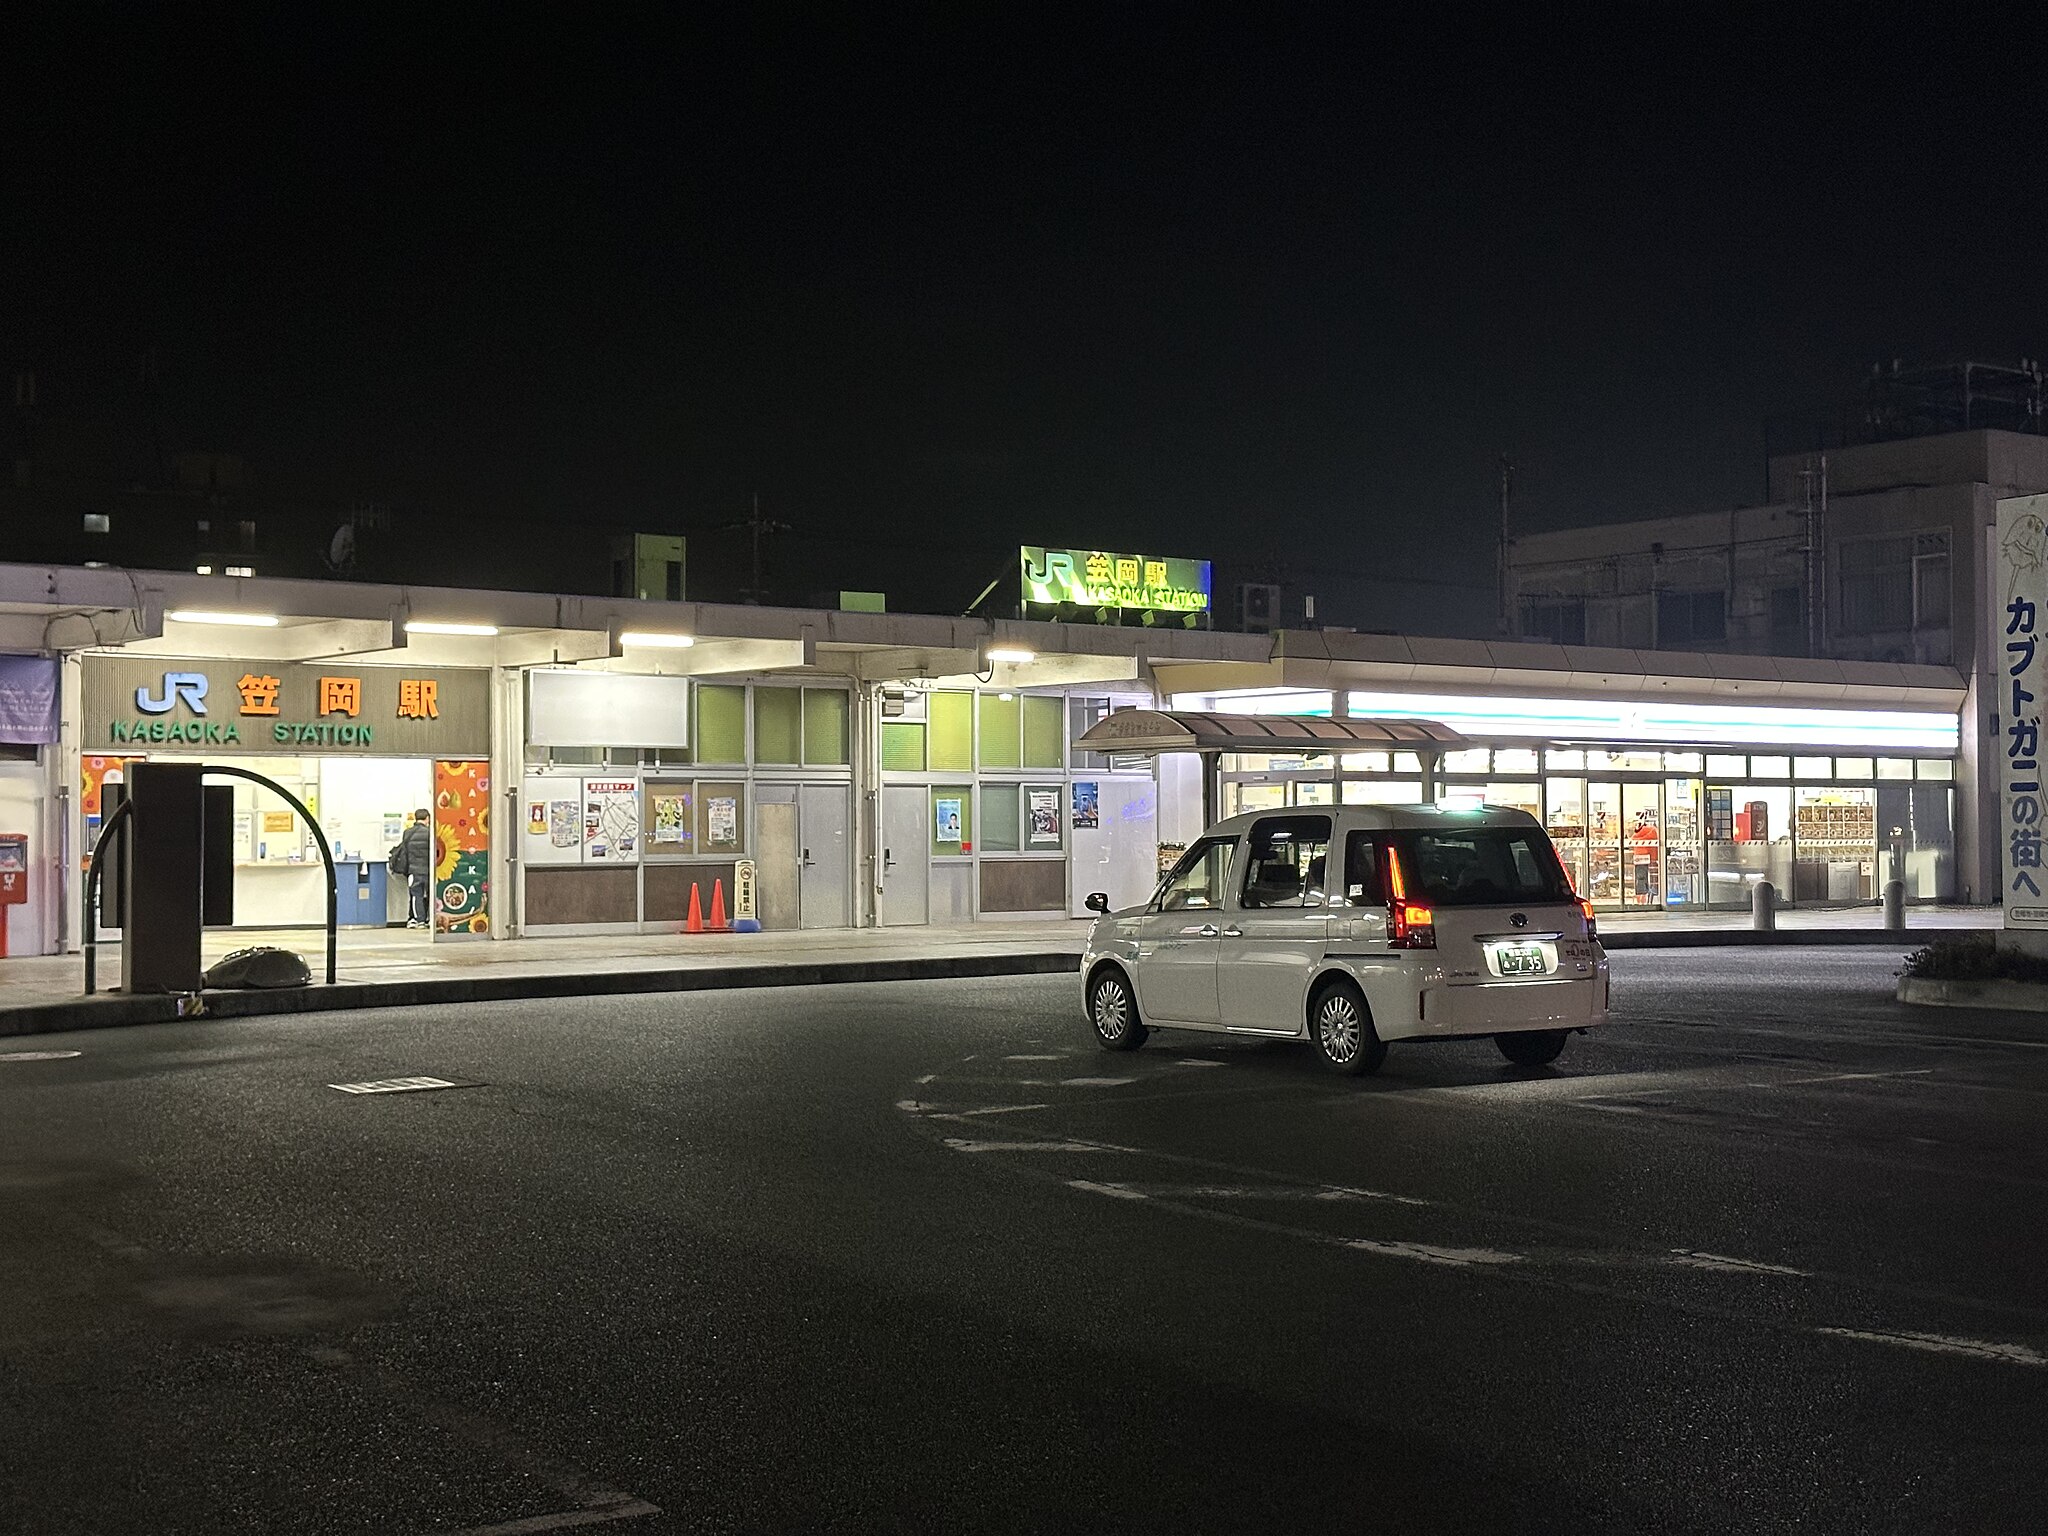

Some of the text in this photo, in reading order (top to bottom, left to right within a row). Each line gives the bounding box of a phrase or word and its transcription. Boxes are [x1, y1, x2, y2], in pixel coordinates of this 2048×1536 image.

[1029, 553, 1168, 586] JR 笠岡駅
[1087, 586, 1208, 609] KASAOKA STATION
[136, 672, 441, 719] JR 笠岡駅
[111, 720, 375, 748] KASAOKA STATION
[2005, 595, 2042, 897] カブトガニの街へ
